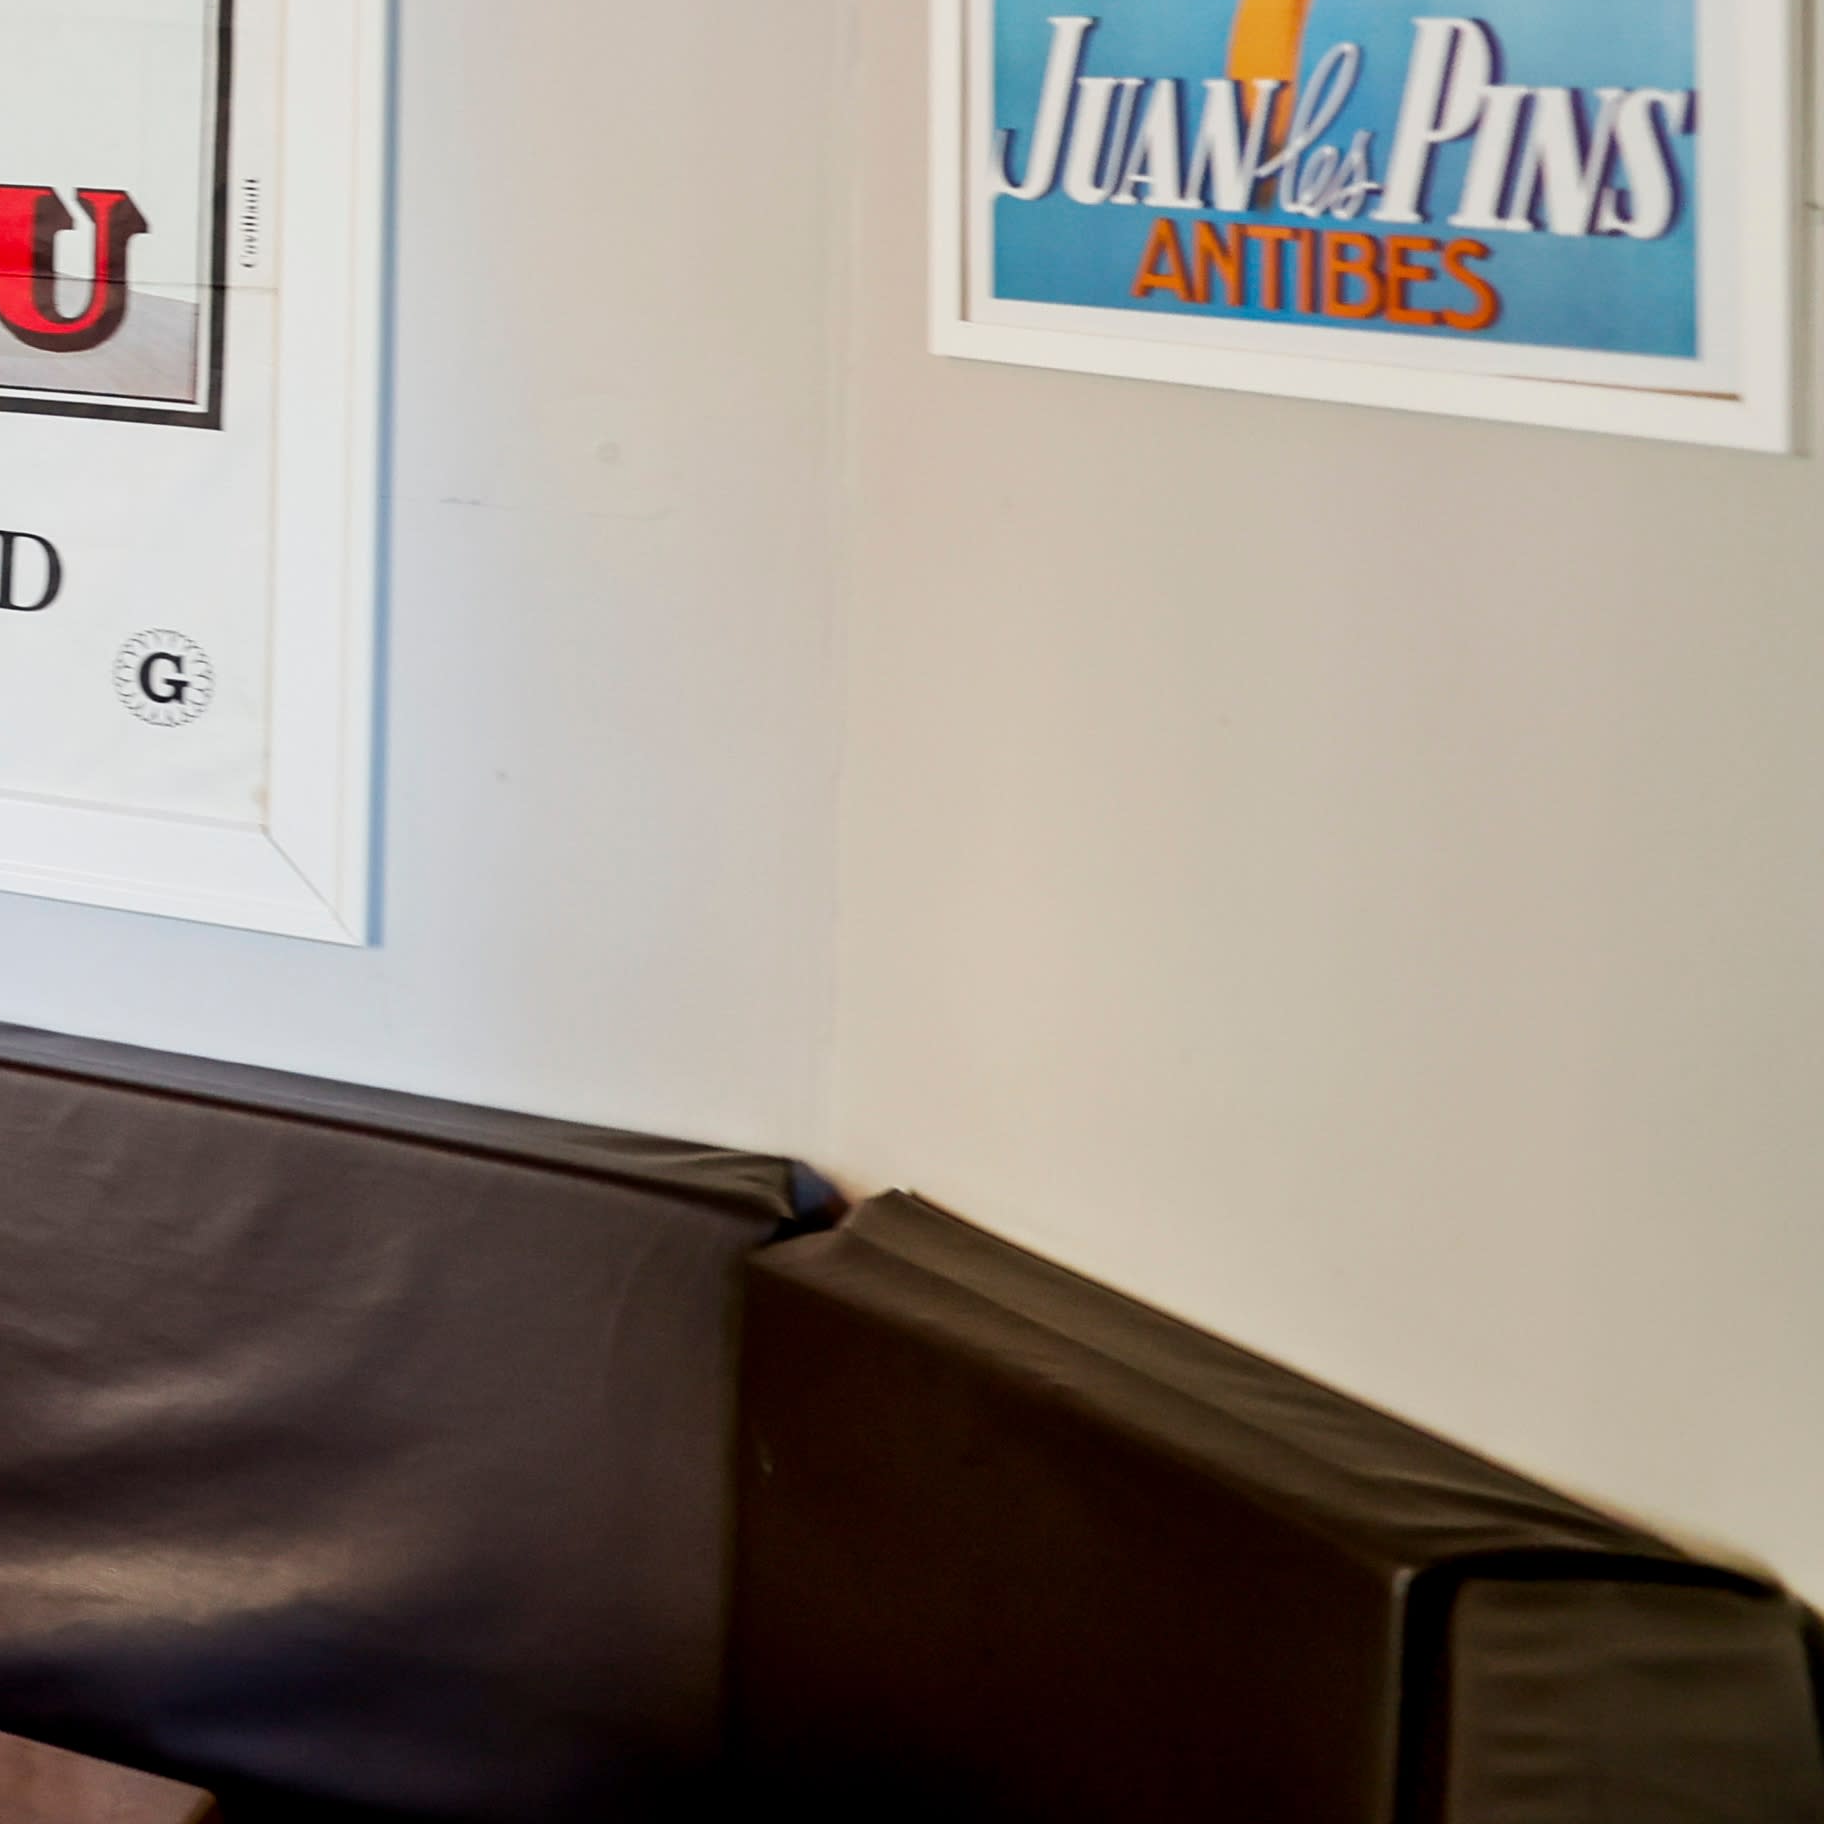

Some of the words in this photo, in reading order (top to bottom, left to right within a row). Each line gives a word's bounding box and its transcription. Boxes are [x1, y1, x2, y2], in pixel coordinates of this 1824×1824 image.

[992, 15, 1290, 212] JUAN
[1256, 43, 1382, 218] les
[1372, 17, 1697, 239] PINS
[1131, 218, 1500, 330] ANTIBES
[139, 650, 191, 705] G
